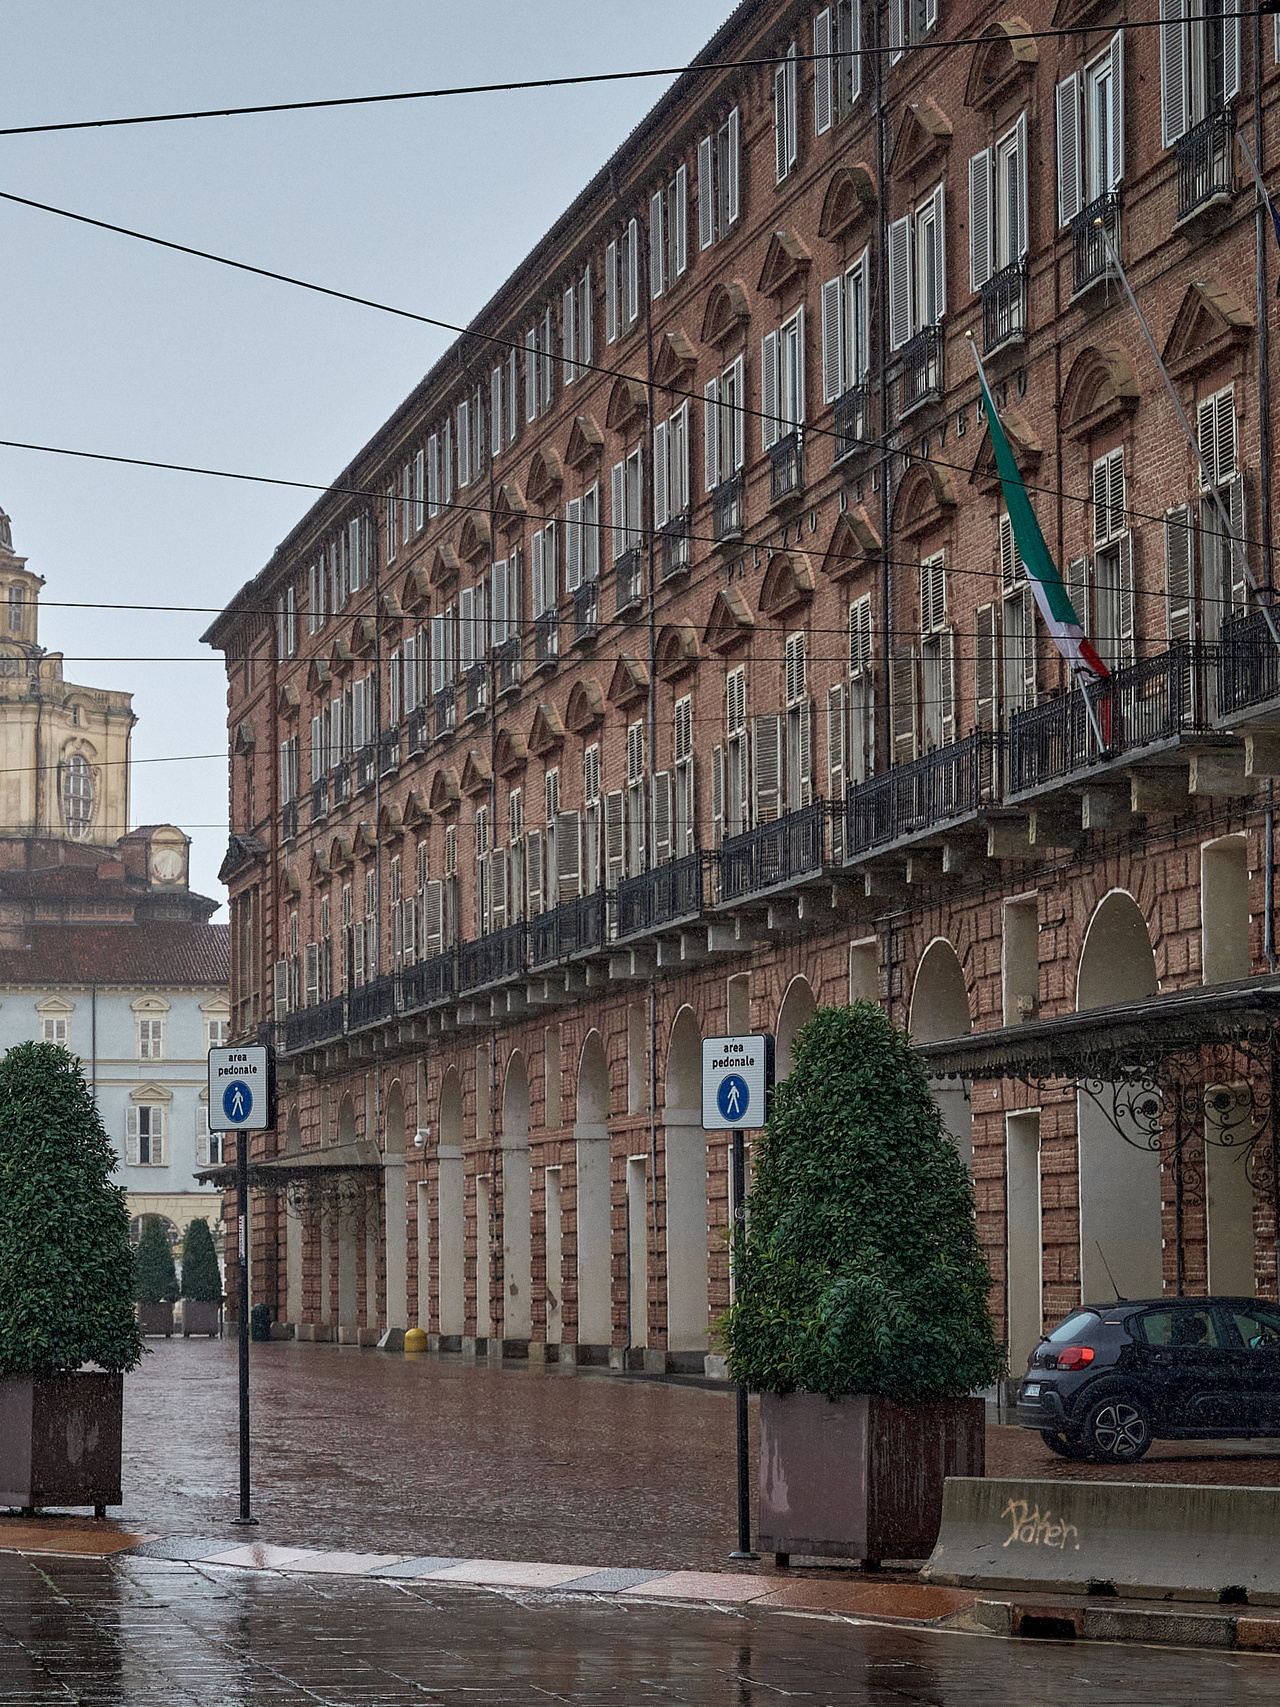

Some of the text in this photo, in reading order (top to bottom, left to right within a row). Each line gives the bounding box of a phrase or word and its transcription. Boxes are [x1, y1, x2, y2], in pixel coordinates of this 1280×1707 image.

[723, 1044, 743, 1053] area
[712, 1055, 755, 1070] pedonale
[218, 1064, 257, 1077] pedonale
